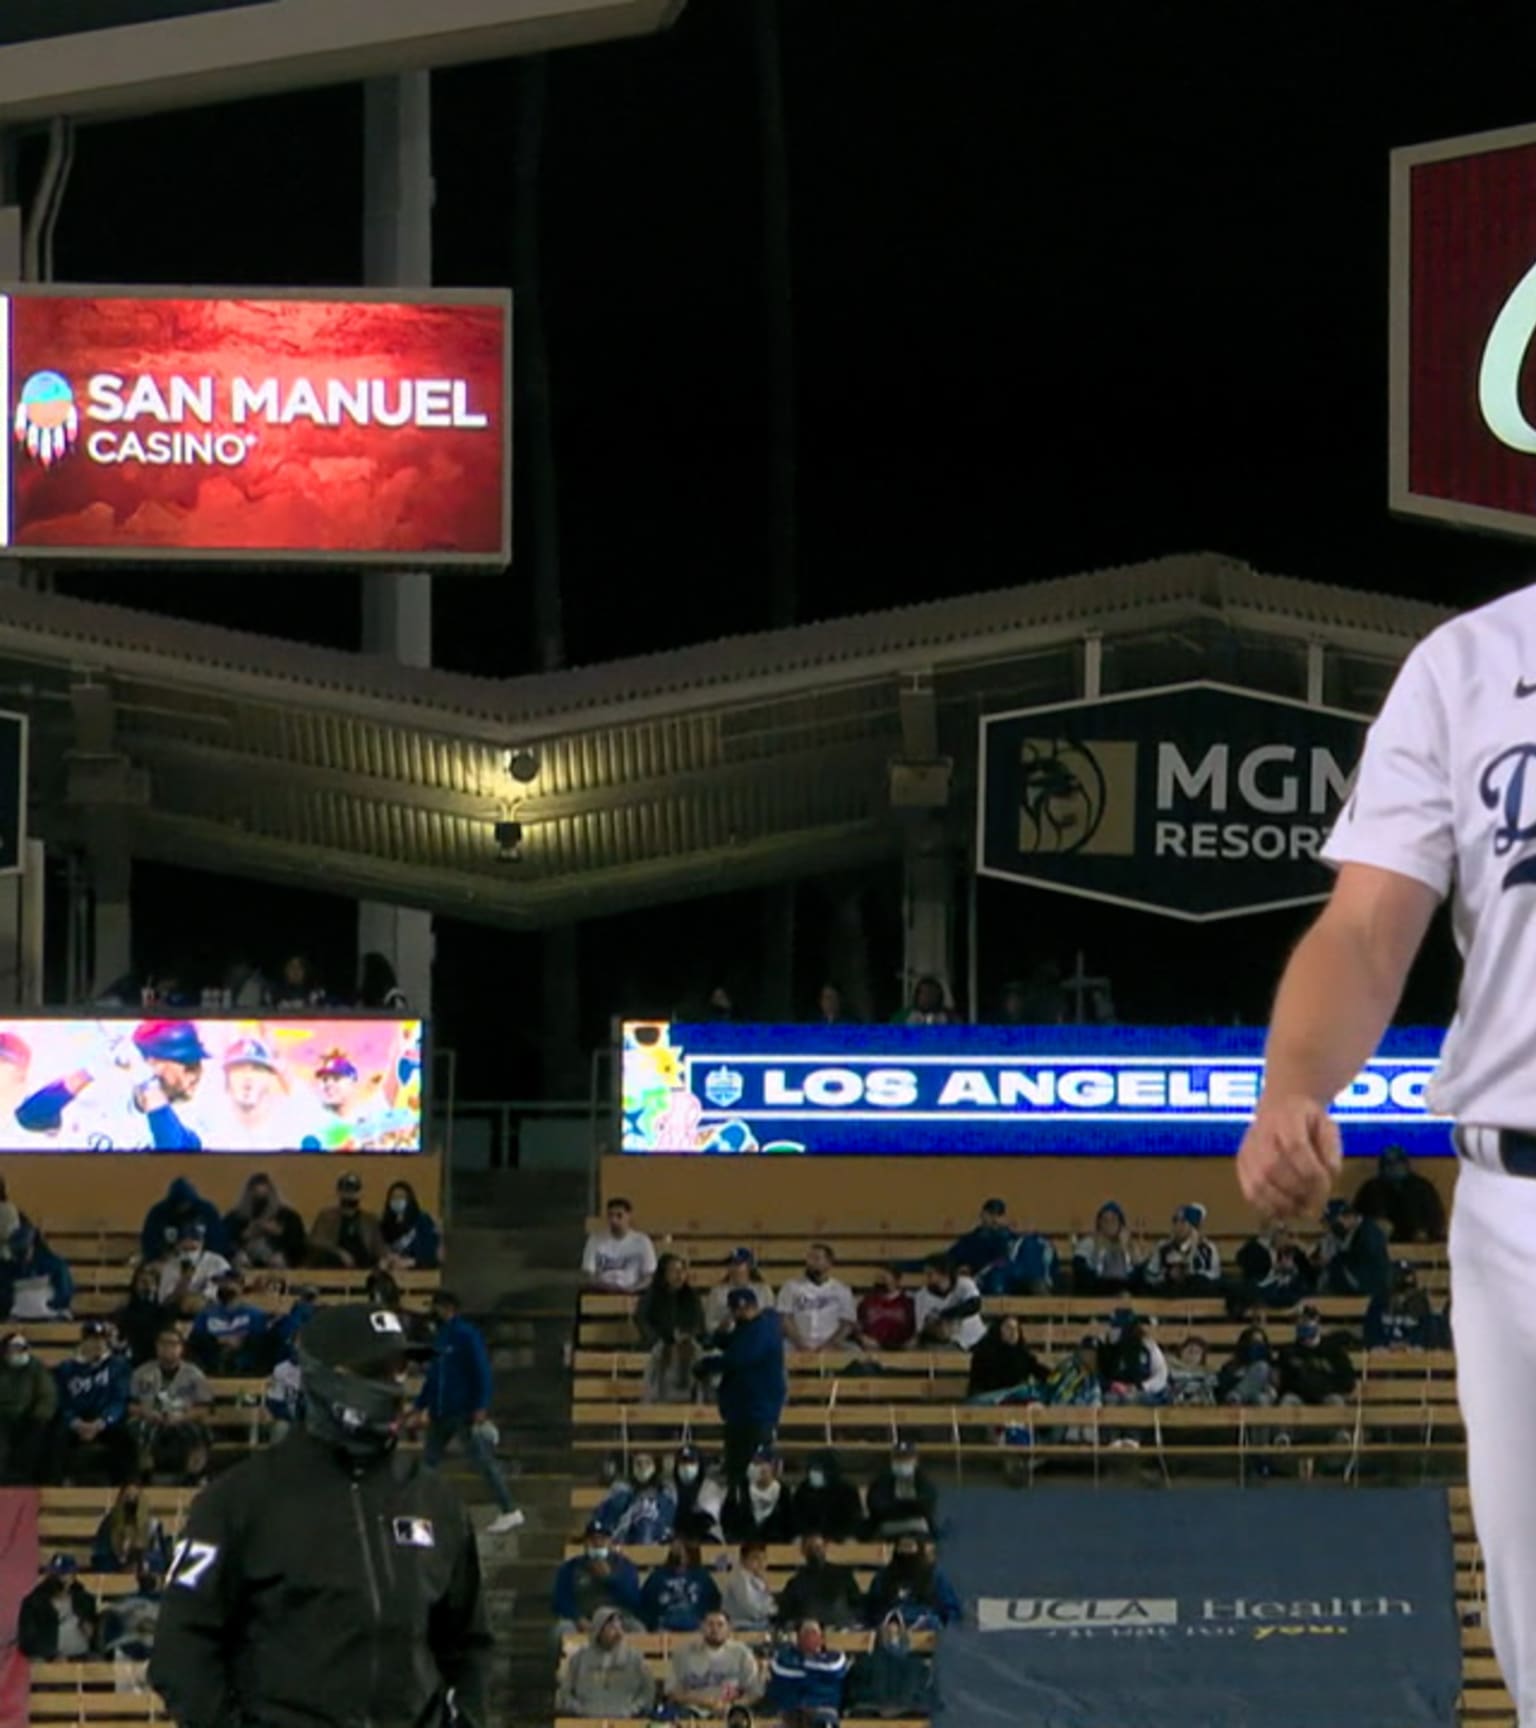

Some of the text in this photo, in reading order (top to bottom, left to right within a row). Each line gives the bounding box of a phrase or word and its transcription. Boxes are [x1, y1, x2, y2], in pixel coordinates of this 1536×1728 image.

[86, 374, 489, 427] SAN MANUEL
[1155, 822, 1334, 860] RESOR
[764, 1070, 918, 1105] LOS
[937, 1071, 1266, 1107] ANGELE
[1007, 1597, 1412, 1621] UCLA Health
